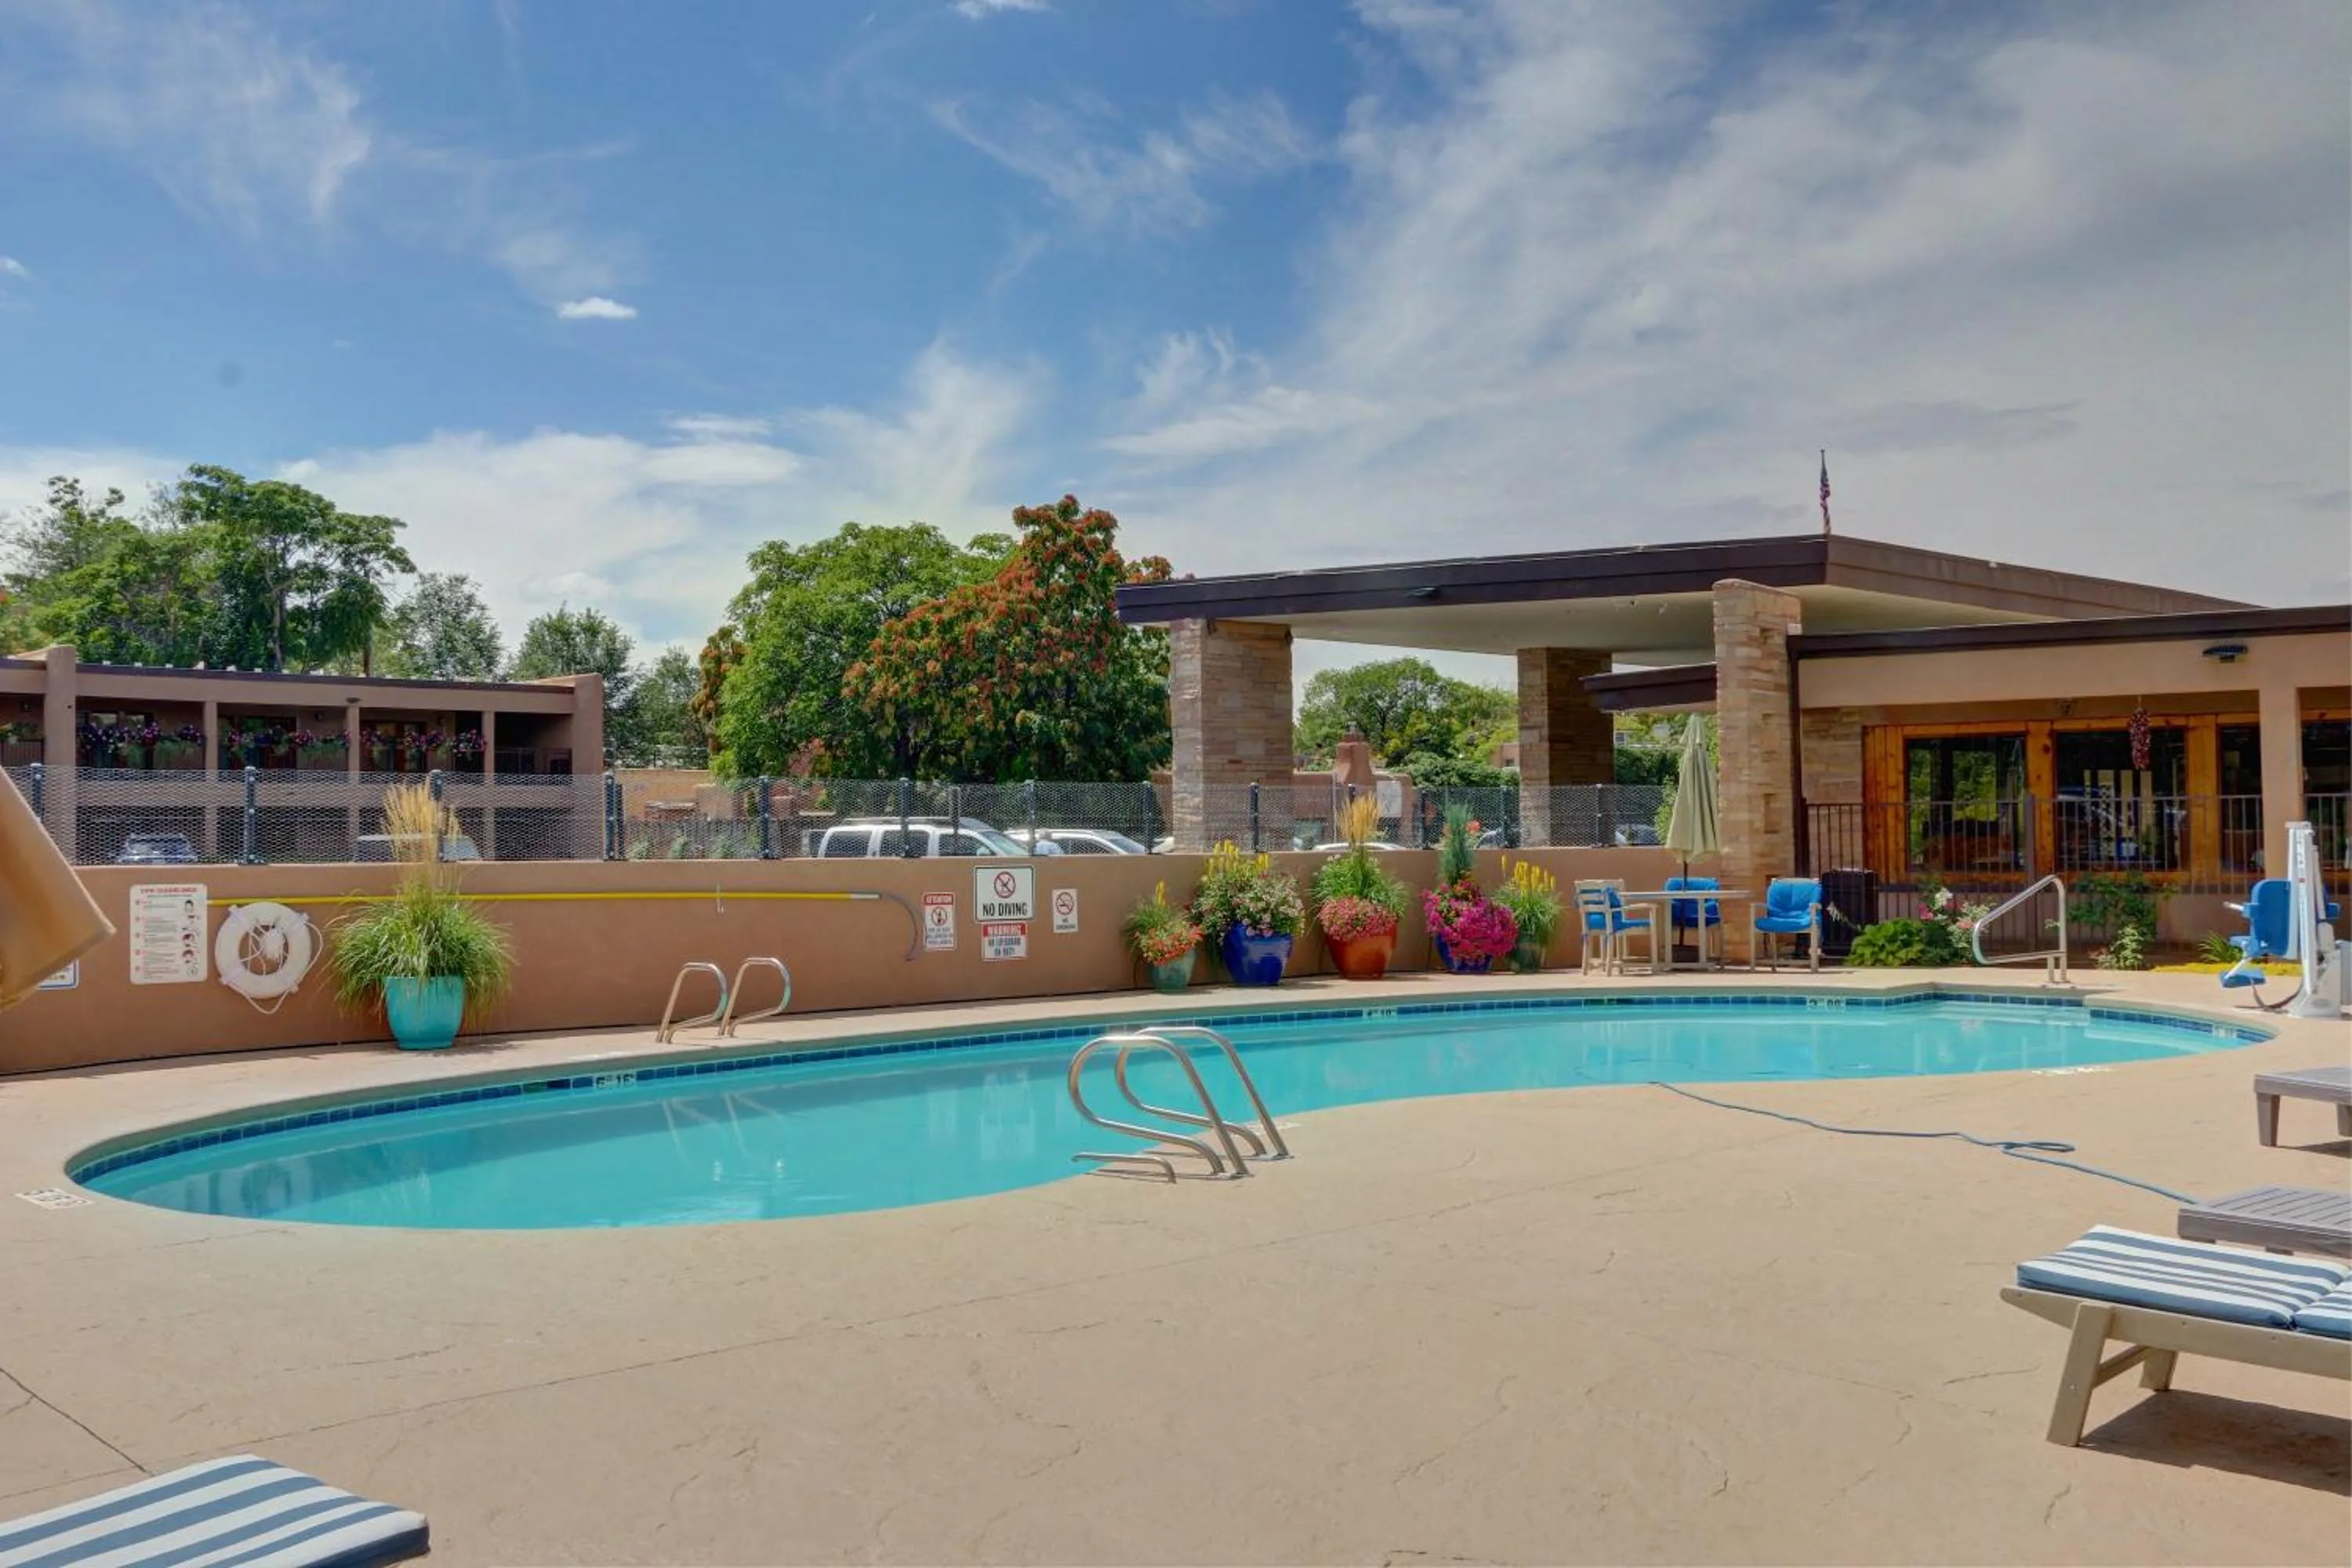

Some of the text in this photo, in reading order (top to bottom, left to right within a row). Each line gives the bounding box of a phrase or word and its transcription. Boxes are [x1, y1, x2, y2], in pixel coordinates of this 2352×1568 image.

[982, 902, 1028, 916] NO DIVING
[987, 924, 1022, 936] WARNING
